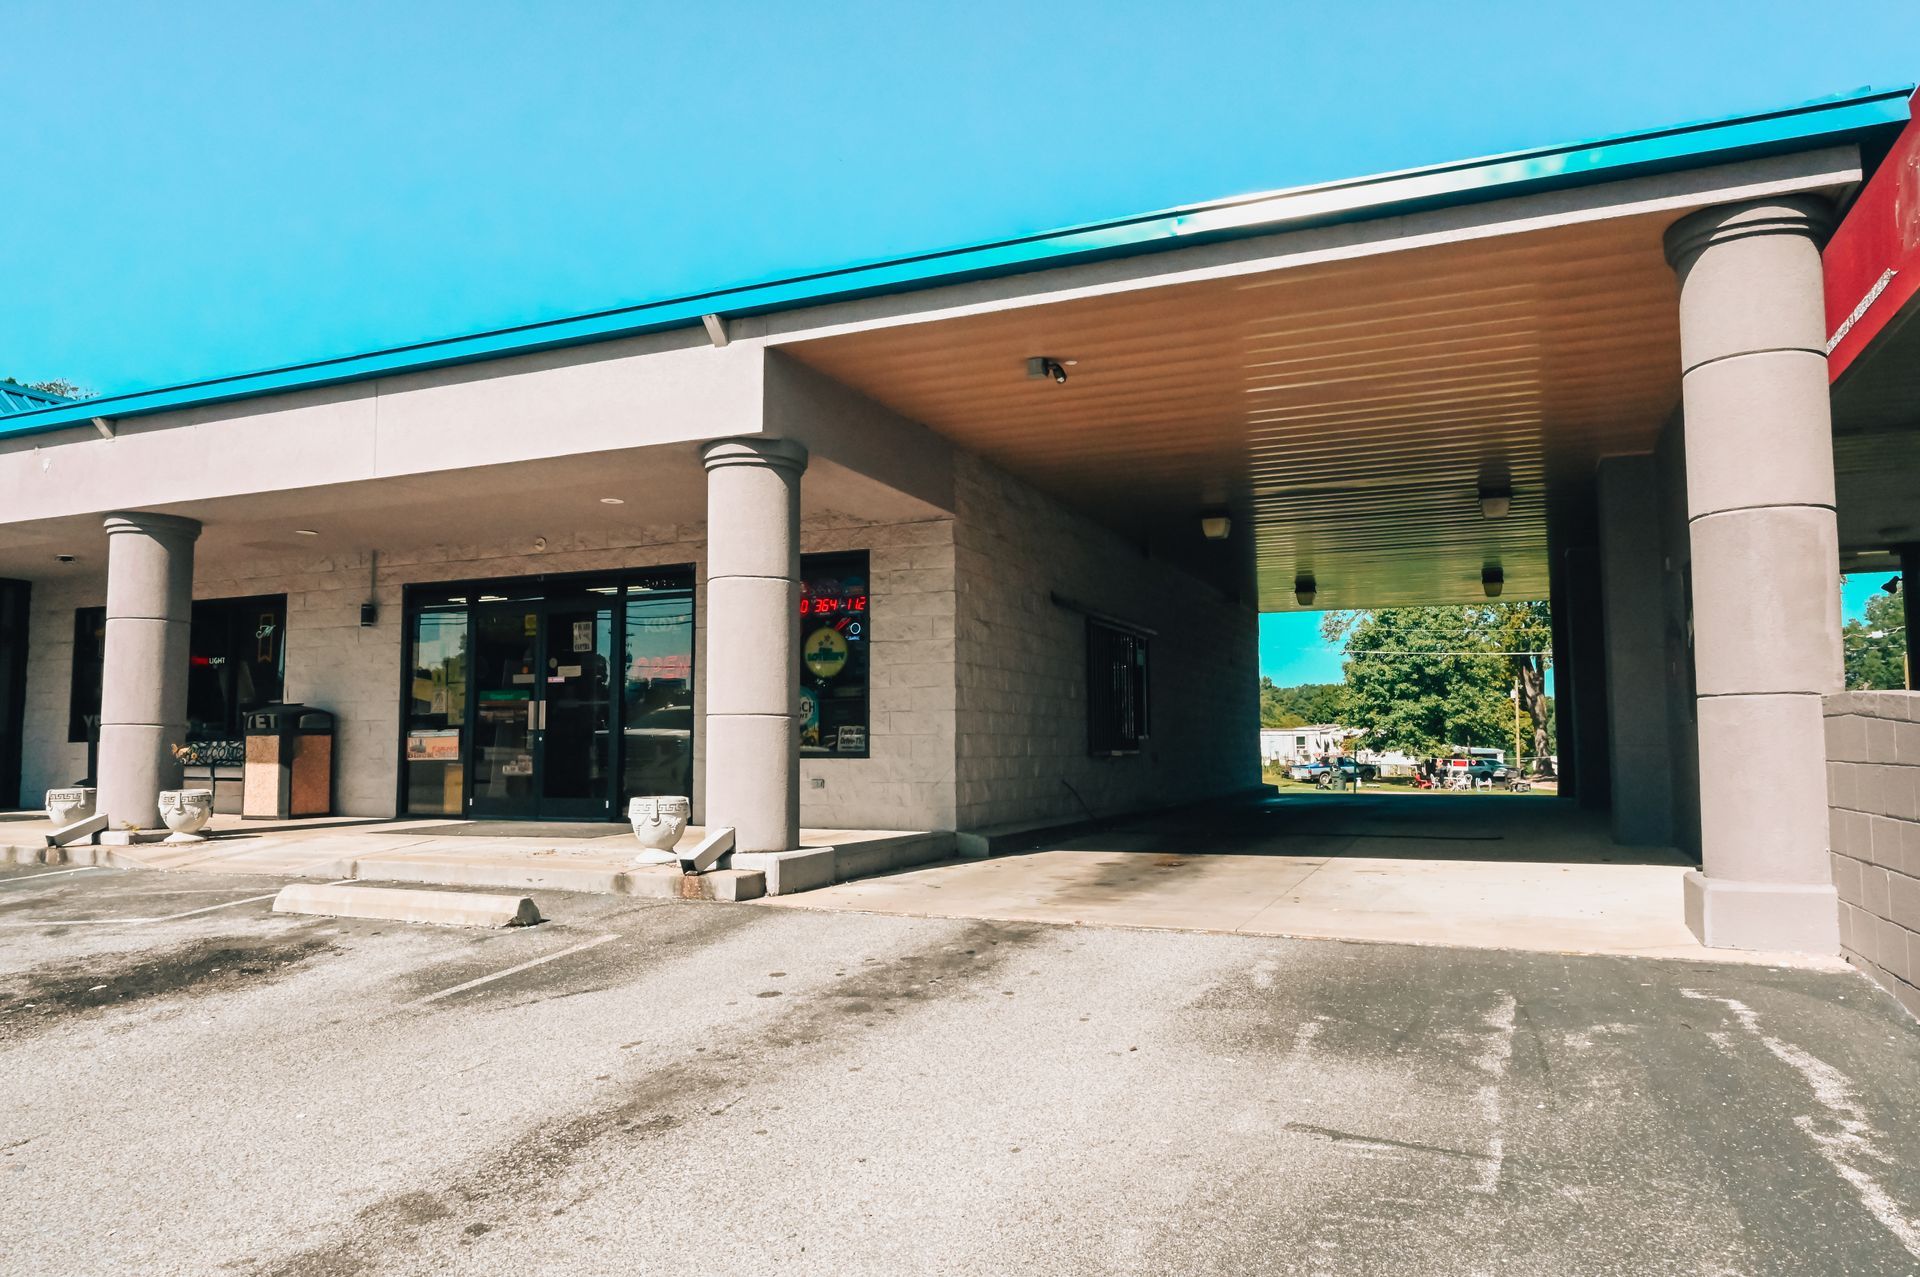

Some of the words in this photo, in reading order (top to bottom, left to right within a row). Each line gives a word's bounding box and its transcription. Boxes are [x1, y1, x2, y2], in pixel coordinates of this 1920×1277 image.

[814, 598, 838, 613] 364
[208, 656, 226, 665] LIGHT
[635, 655, 691, 679] OPEN
